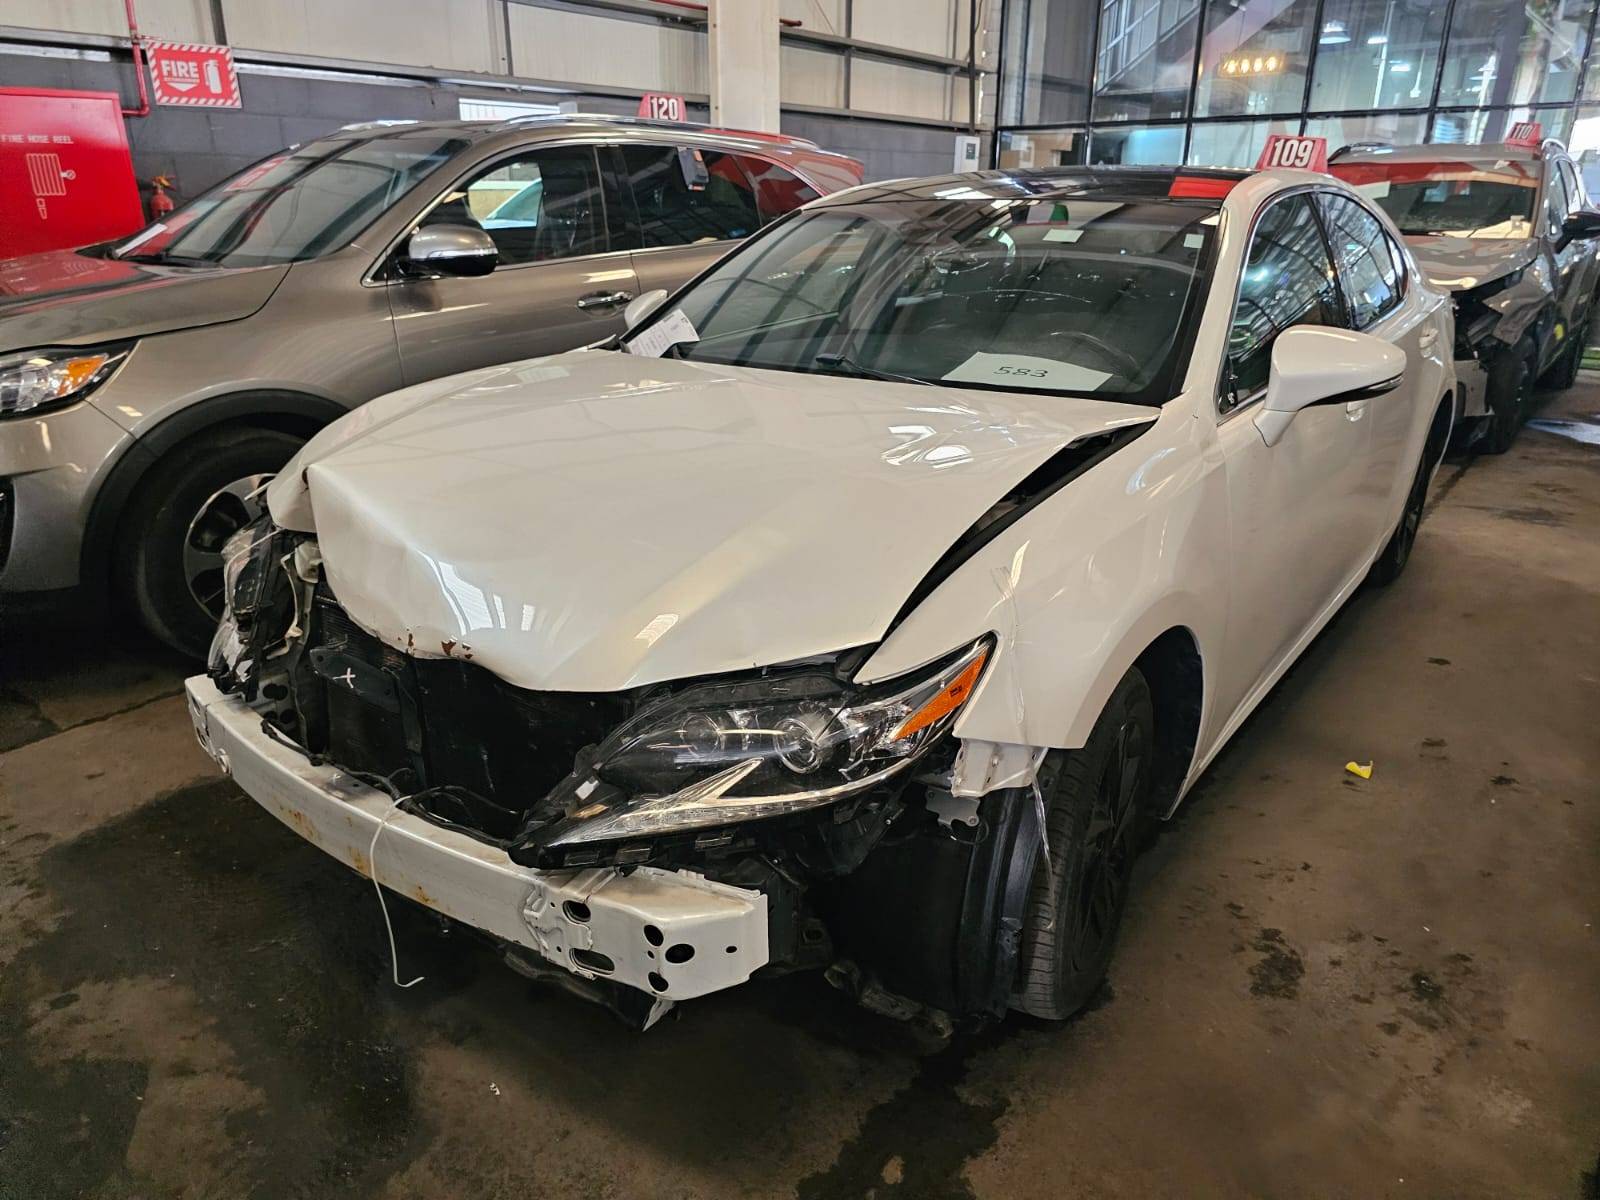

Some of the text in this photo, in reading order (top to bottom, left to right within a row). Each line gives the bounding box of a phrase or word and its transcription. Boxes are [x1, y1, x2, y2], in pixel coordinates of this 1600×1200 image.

[161, 60, 198, 78] FIRE
[650, 97, 679, 120] 120
[1, 134, 24, 144] FIRE
[1511, 124, 1533, 139] 110
[1271, 139, 1314, 168] 109
[993, 366, 1049, 378] 583
